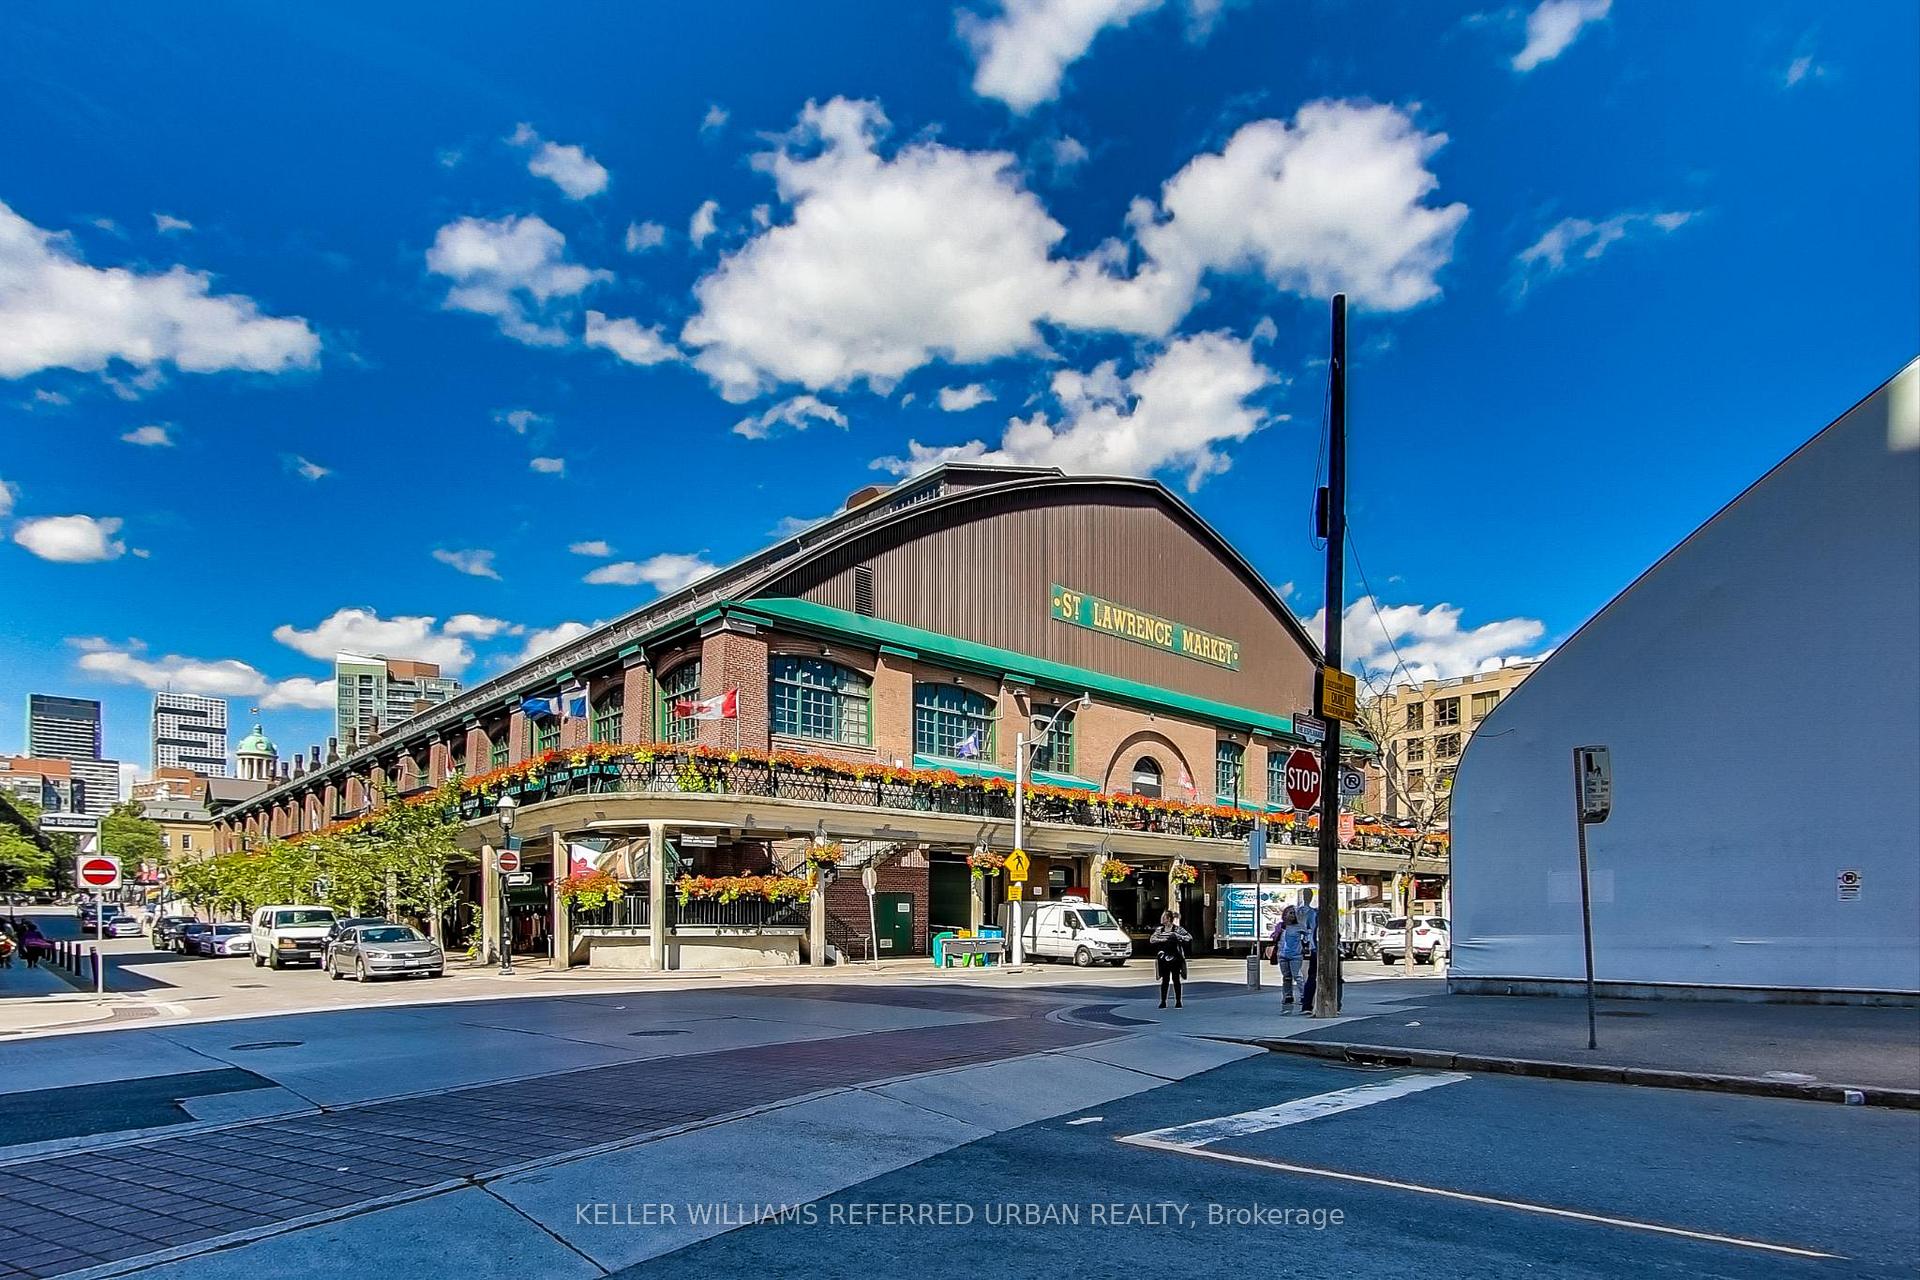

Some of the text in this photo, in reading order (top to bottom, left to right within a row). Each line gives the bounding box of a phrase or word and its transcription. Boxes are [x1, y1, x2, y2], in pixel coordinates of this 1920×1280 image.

[1093, 602, 1173, 647] LAWRENCE
[1182, 629, 1232, 665] MARKET
[1287, 767, 1319, 793] STOP
